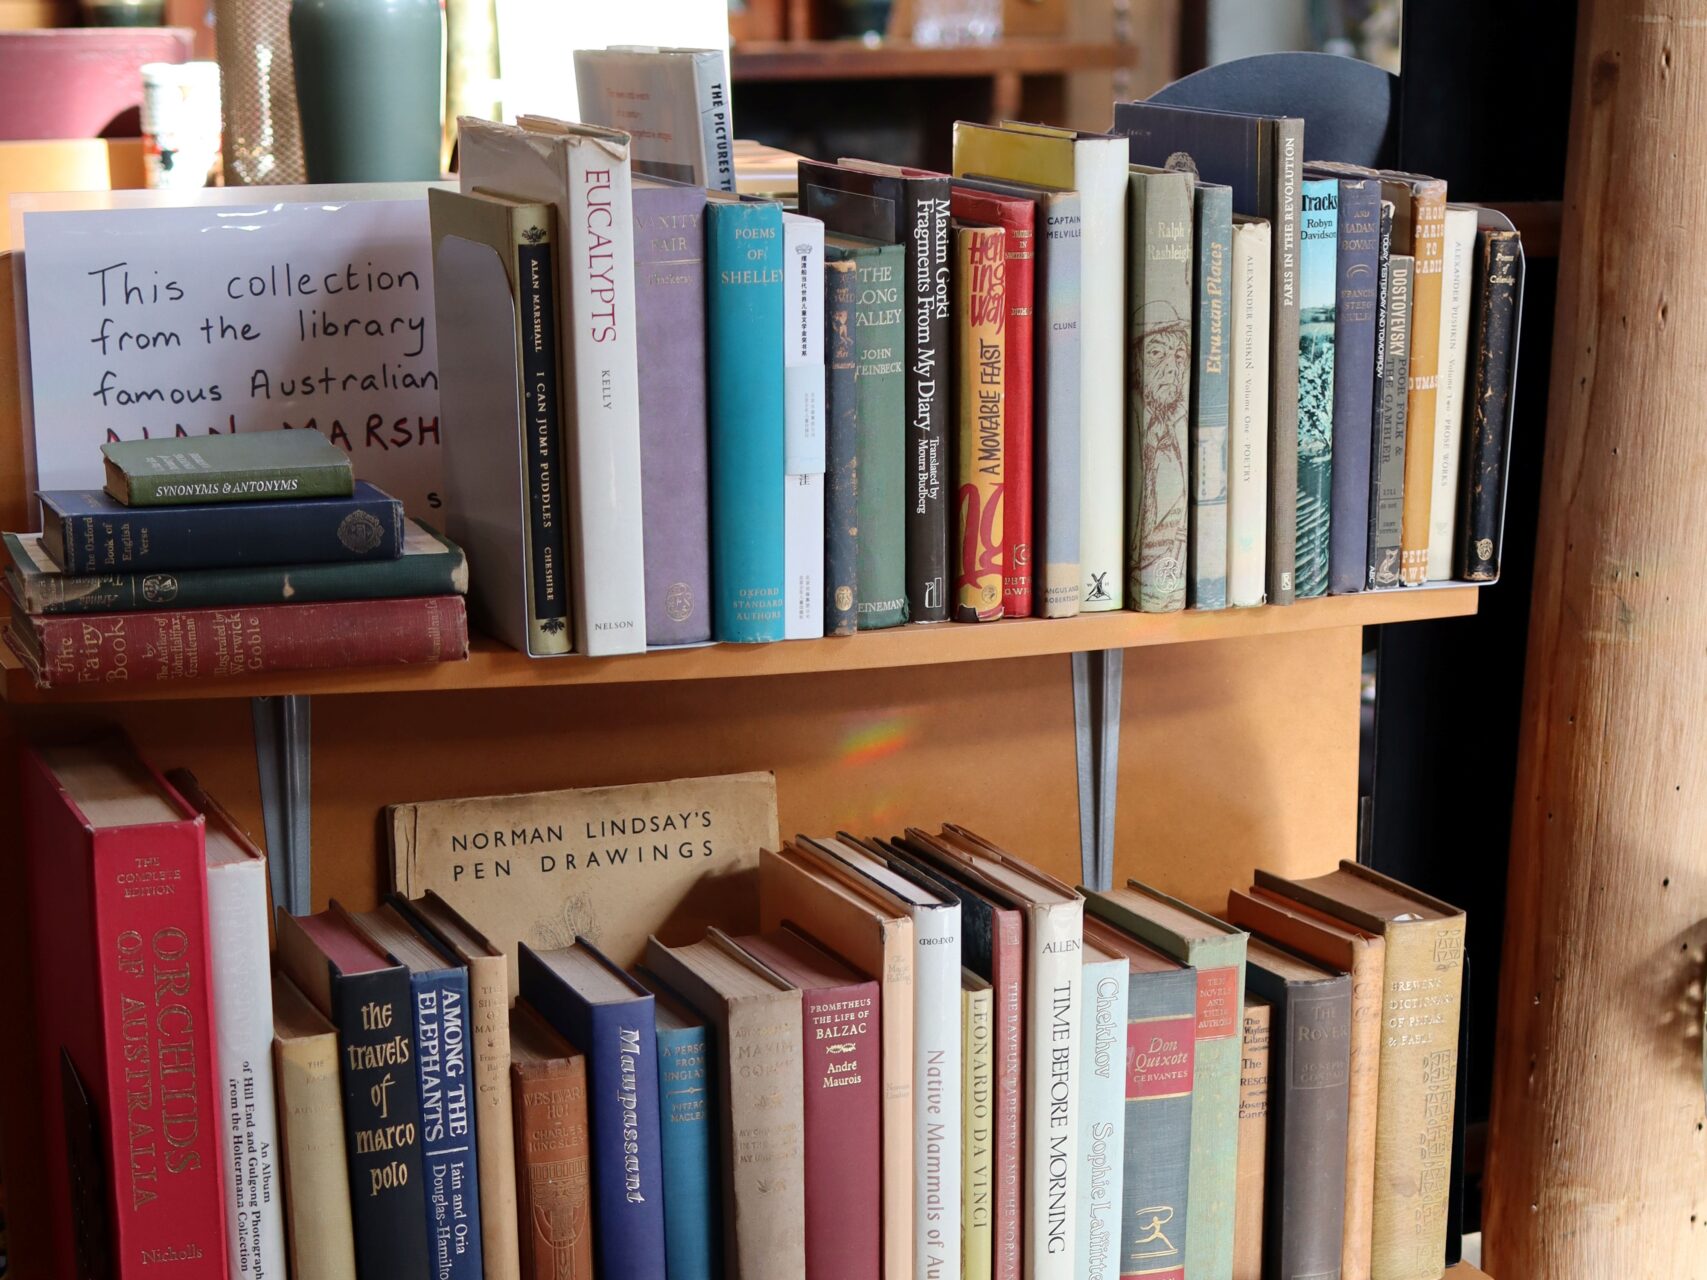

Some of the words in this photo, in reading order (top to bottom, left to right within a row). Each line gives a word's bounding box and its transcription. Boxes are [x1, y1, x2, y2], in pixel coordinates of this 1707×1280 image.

[712, 84, 724, 106] THE
[715, 113, 729, 177] PICTURES
[1285, 138, 1295, 217] REVOLUTION
[1047, 216, 1080, 226] CAPTAIN
[1301, 194, 1337, 212] Tracks
[736, 229, 775, 240] POEMS
[936, 200, 951, 264] Maxim
[1158, 222, 1184, 240] Ralph
[1285, 222, 1293, 250] THE
[1300, 230, 1336, 242] Davidson
[1307, 219, 1333, 230] Robyn
[914, 200, 934, 292] Fragments
[1285, 254, 1293, 268] IN
[88, 262, 184, 306] This
[228, 262, 420, 299] collection
[531, 260, 539, 289] ALAN
[586, 169, 616, 343] EUCALYPTS
[602, 369, 612, 409] KELLY
[859, 266, 892, 283] THE
[1207, 242, 1221, 296] Places
[1284, 272, 1294, 306] PARIS
[936, 268, 950, 320] Gorki
[1390, 268, 1407, 356] DOSTOYEVSKY
[91, 318, 181, 355] from
[201, 315, 261, 343] the
[299, 309, 425, 357] library
[533, 294, 542, 352] MARSHALL
[918, 297, 934, 344] From
[1053, 322, 1076, 331] CLUNE
[1207, 299, 1221, 373] Etruscan
[861, 348, 891, 360] JOHN
[914, 348, 934, 378] My
[980, 338, 1000, 385] FEAST
[93, 371, 223, 406] famous
[250, 364, 440, 401] Australian
[537, 383, 547, 412] CAN
[914, 381, 934, 432] Diary
[537, 416, 549, 456] JUMP
[979, 392, 1000, 462] MOVEABLE
[918, 440, 928, 471] Moura
[929, 437, 939, 484] Translated
[979, 463, 1000, 475] A
[156, 482, 219, 497] SYNONYMS
[232, 480, 298, 493] ANTONYMS
[540, 463, 552, 527] PUDDLES
[916, 473, 928, 515] Budberg
[930, 487, 939, 500] by
[544, 547, 553, 600] CHESHIRE
[595, 620, 634, 630] NELSON
[106, 620, 129, 682] Book
[452, 825, 562, 852] NORMAN
[586, 811, 711, 839] LINDSAY'S
[454, 860, 511, 881] PEN
[541, 841, 713, 872] DRAWINGS
[117, 930, 145, 978] OF
[1042, 938, 1080, 954] ALLEN
[361, 1001, 392, 1031] the
[810, 998, 871, 1014] PROMETHEUS
[1054, 980, 1071, 1041] TIME
[442, 988, 464, 1078] AMONG
[816, 1022, 867, 1040] BALZAC
[1094, 977, 1119, 1079] Chekhov
[1146, 1037, 1177, 1055] Don
[152, 926, 201, 1173] ORCHIDS
[347, 1035, 409, 1071] travels
[417, 991, 444, 1142] ELEPHANTS
[827, 1060, 857, 1074] André
[974, 998, 988, 1119] LEONARDO
[1134, 1051, 1187, 1075] Quixote
[370, 1073, 396, 1118] of
[823, 1074, 862, 1089] Maurois
[927, 1050, 944, 1116] Native
[1050, 1048, 1069, 1128] BEFORE
[1132, 1070, 1187, 1086] CERVANTES
[120, 993, 158, 1211] AUSTRALIA
[447, 1083, 468, 1137] THE
[618, 1026, 645, 1203] Maupassant
[356, 1123, 414, 1154] marco
[974, 1128, 987, 1158] DA
[370, 1161, 408, 1197] polo
[450, 1161, 464, 1188] Iain
[927, 1122, 944, 1222] Mammals
[1087, 1122, 1113, 1197] Sophie
[453, 1193, 467, 1220] and
[974, 1165, 987, 1229] VINCI
[1047, 1136, 1068, 1255] MORNING
[455, 1223, 468, 1254] Oria
[927, 1229, 944, 1247] of
